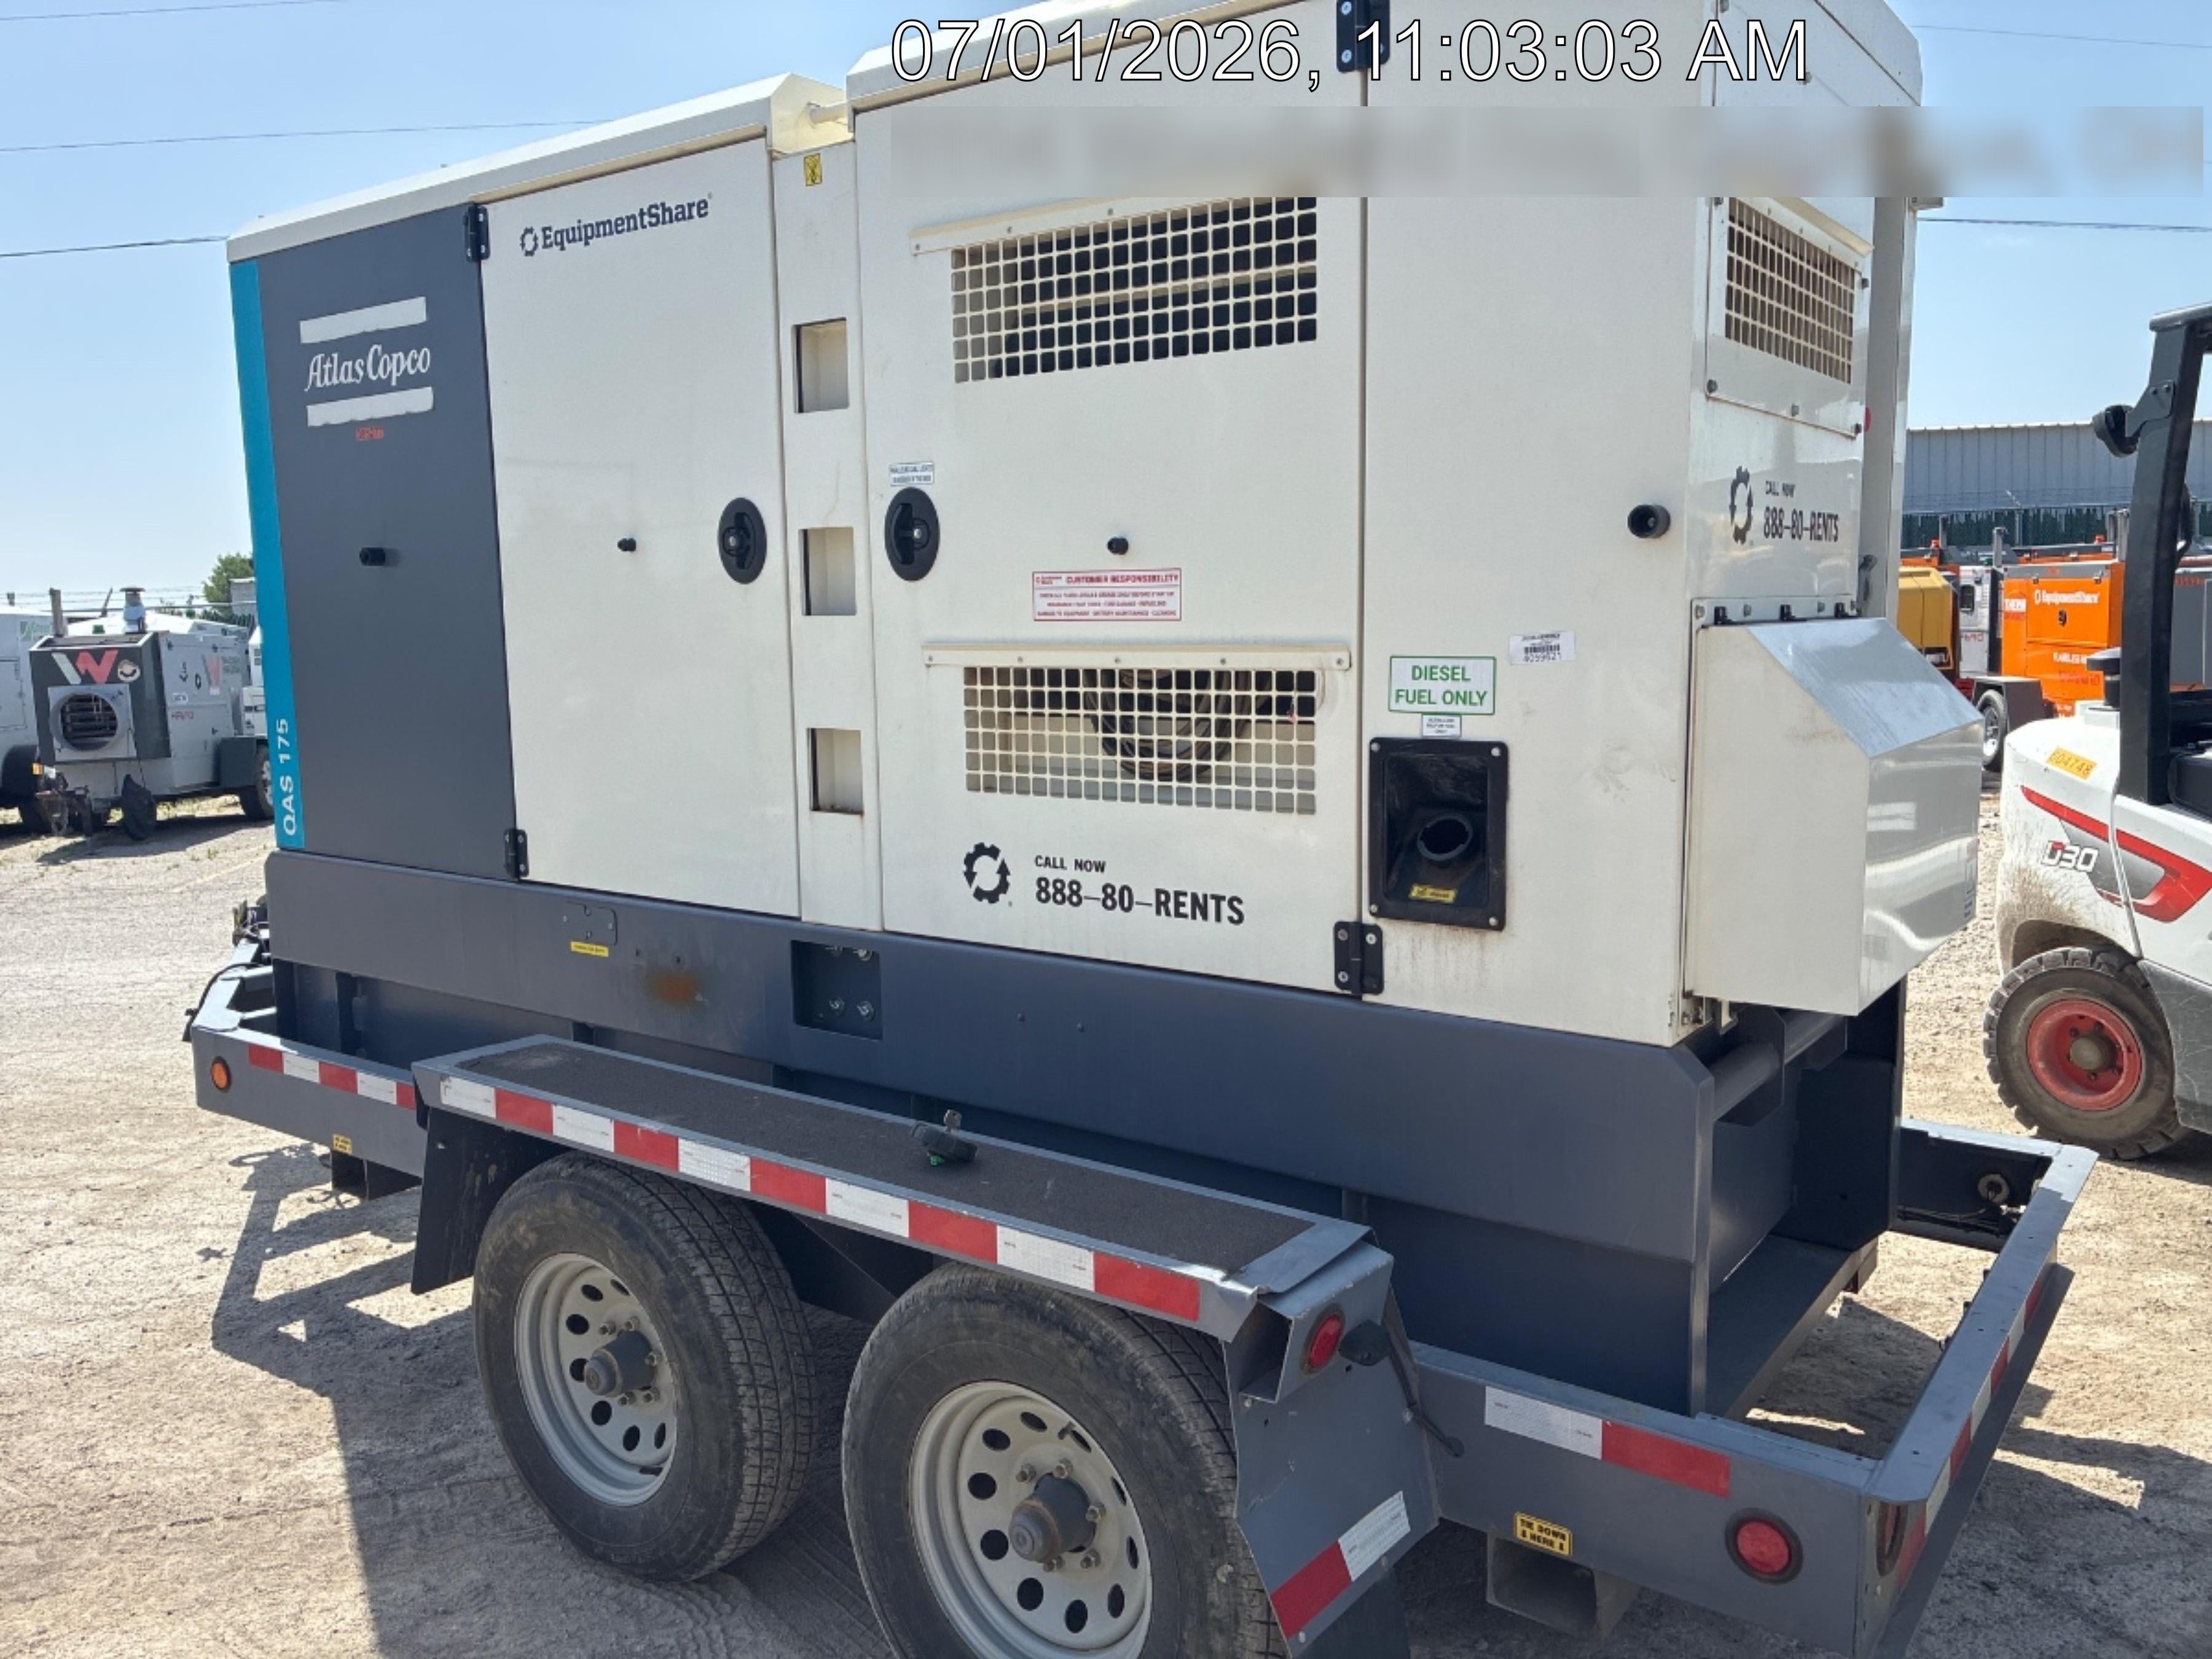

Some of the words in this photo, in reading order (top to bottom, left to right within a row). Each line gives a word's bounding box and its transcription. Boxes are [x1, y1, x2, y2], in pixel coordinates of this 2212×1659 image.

[541, 198, 710, 251] EquipmentShare
[304, 351, 364, 392] Atlas
[366, 343, 431, 386] Copco
[1765, 480, 1779, 496] CALL
[1781, 482, 1796, 498] NOW
[1763, 506, 1839, 543] 888-80-RENTS
[1411, 665, 1471, 681] DIESEL
[1395, 689, 1437, 705] FUEL
[1441, 690, 1488, 707] ONLY
[276, 718, 291, 764] 175
[280, 774, 297, 836] QAS
[1034, 855, 1067, 871] CALL
[1074, 858, 1107, 874] NOW
[2041, 840, 2099, 873] D30
[1035, 876, 1245, 926] 888-80-RENTS
[1529, 1531, 1555, 1548] HERE
[1537, 1523, 1566, 1542] DOWN
